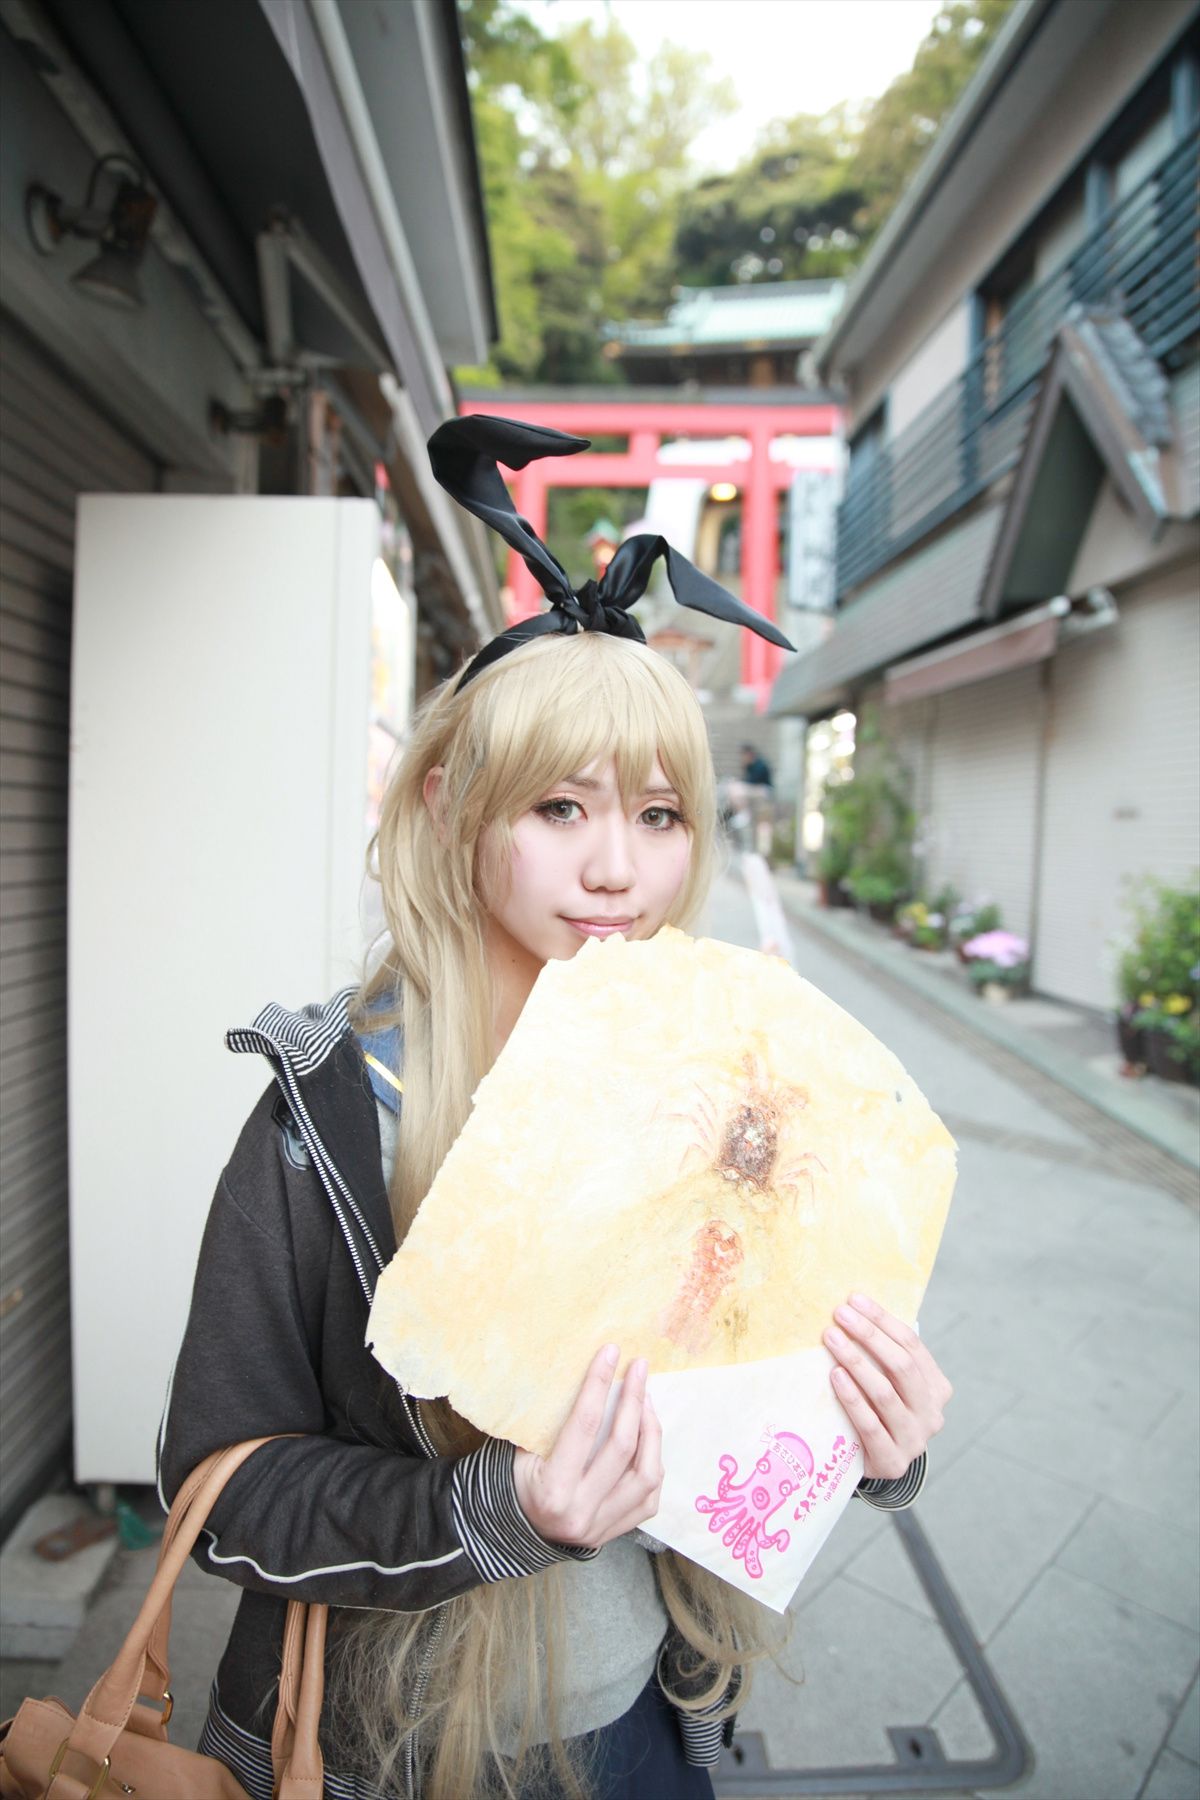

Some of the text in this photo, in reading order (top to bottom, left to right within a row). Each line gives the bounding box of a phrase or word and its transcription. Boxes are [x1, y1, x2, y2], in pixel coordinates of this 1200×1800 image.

[773, 1442, 807, 1481] あさひ本店
